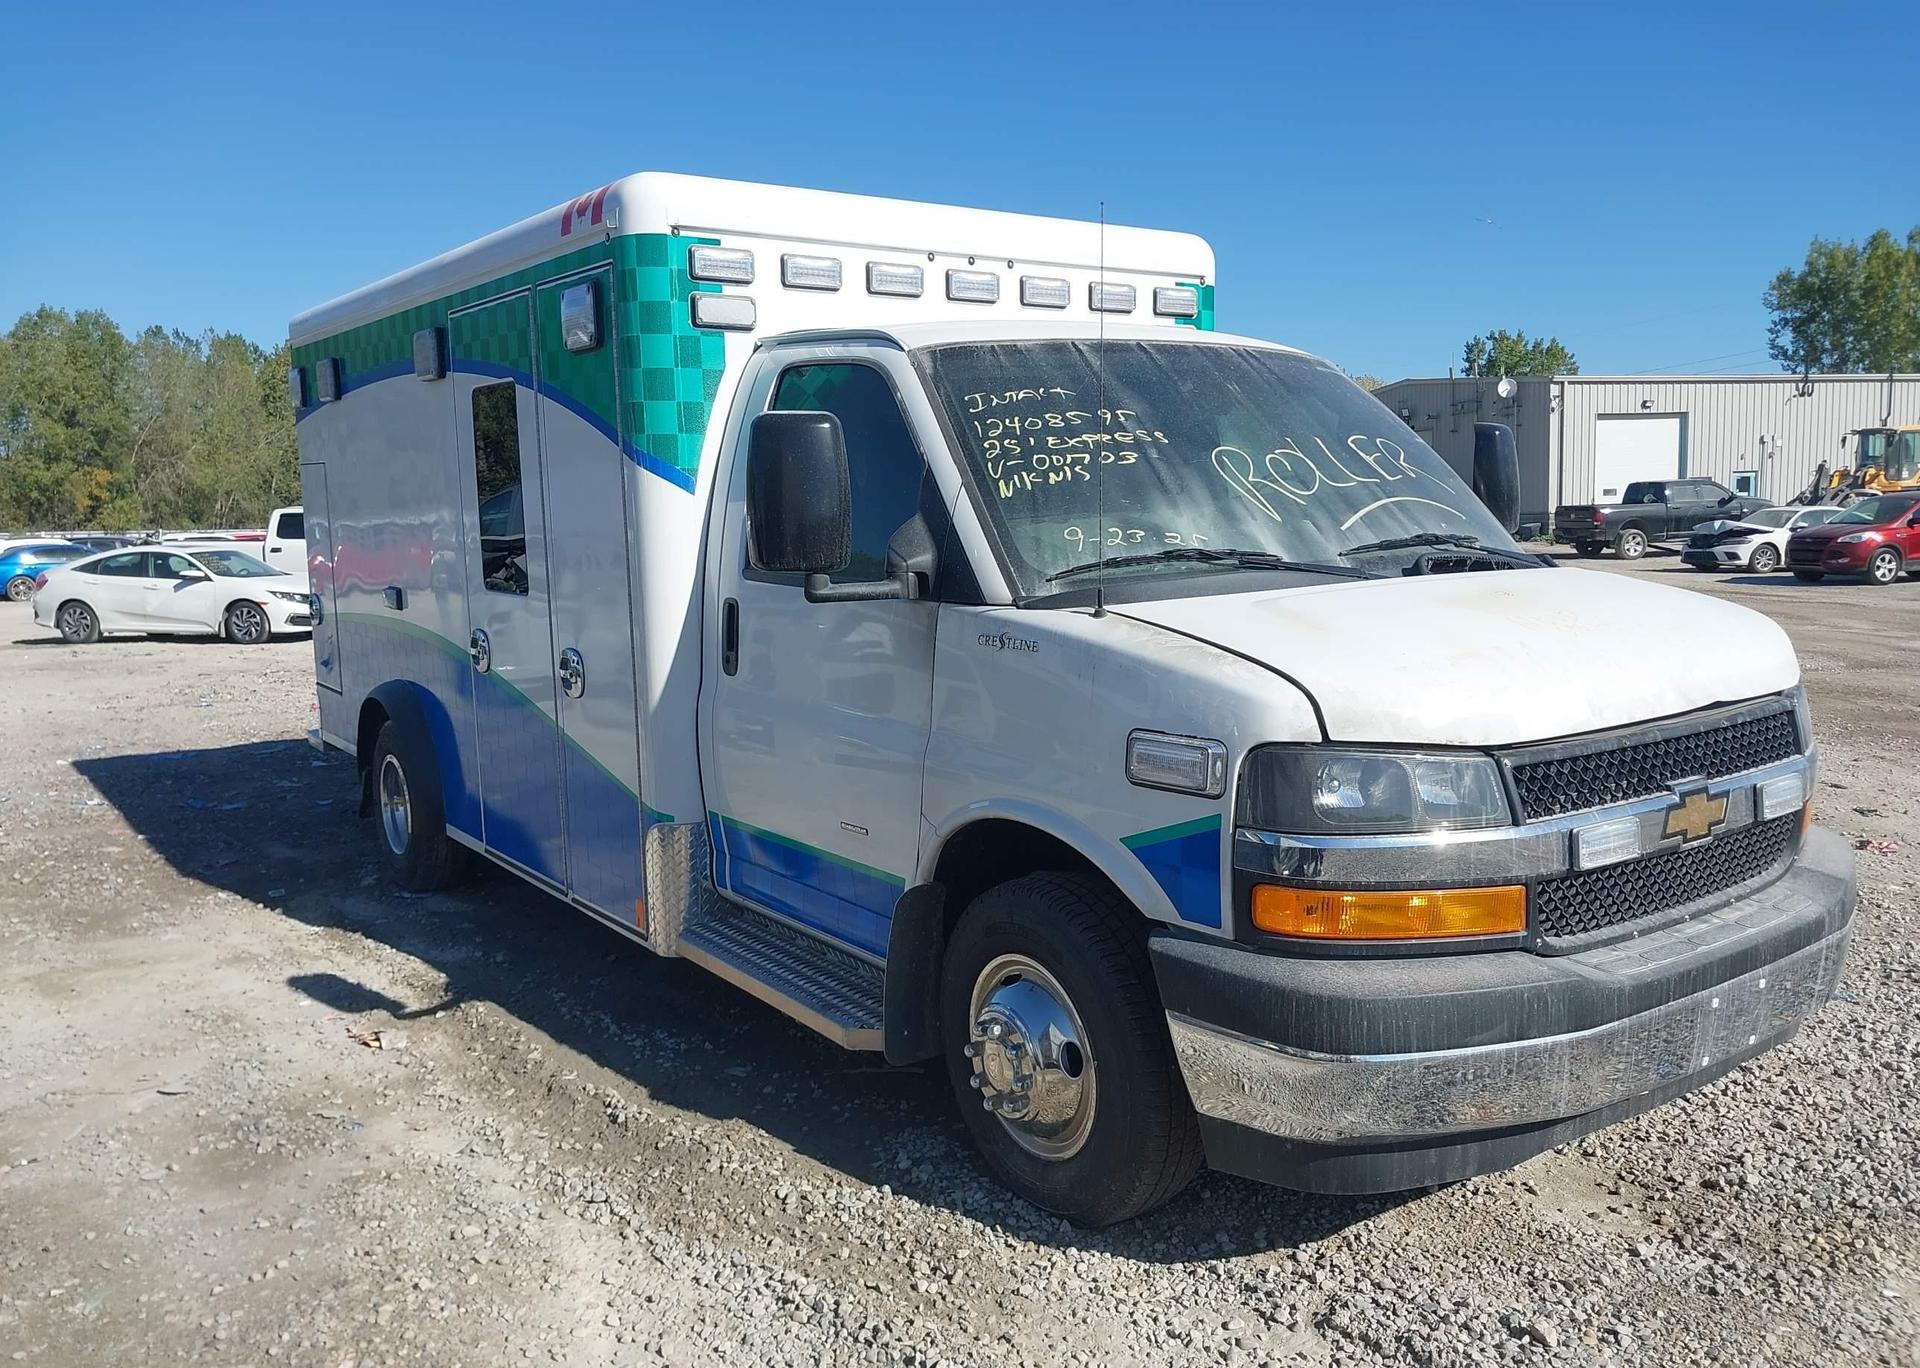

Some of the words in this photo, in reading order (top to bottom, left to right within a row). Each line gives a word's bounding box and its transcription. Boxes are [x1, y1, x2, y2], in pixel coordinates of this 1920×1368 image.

[1046, 429, 1169, 450] EXPRESS
[1211, 434, 1456, 523] ROLLER
[977, 631, 1040, 653] CRESTLINE
